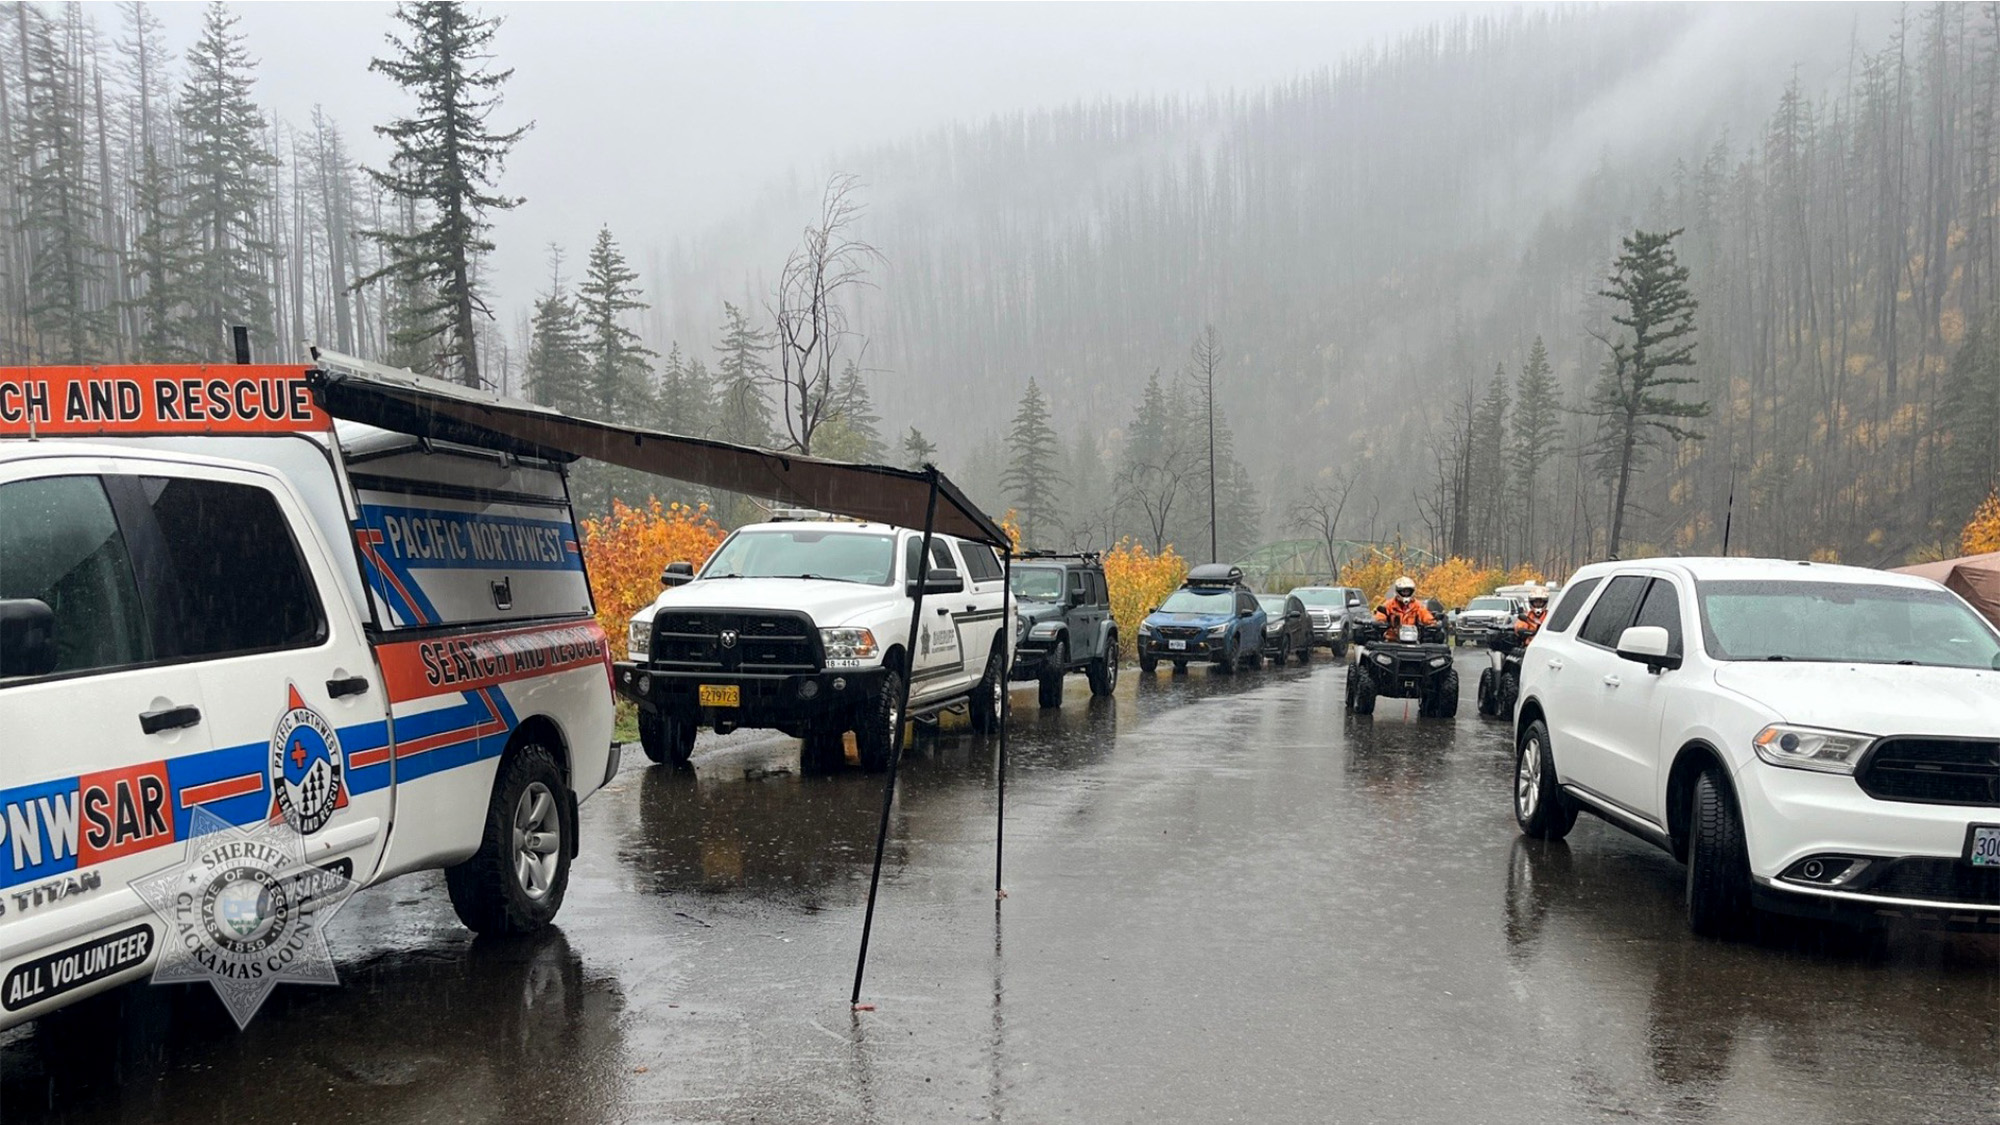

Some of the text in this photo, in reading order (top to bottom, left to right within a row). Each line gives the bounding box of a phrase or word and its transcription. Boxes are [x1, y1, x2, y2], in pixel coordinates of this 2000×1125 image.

[65, 379, 141, 423] AND
[154, 378, 312, 422] RESCUE
[383, 515, 565, 562] PACIFIC NORTHWEST
[419, 627, 601, 687] SEARCH AND RESCUE
[275, 711, 338, 769] PACIFIC NORTHWEST
[276, 774, 341, 833] SEARCH AND RESCUE
[11, 870, 101, 912] TITAN
[9, 931, 149, 1004] ALL VOLUNTEER
